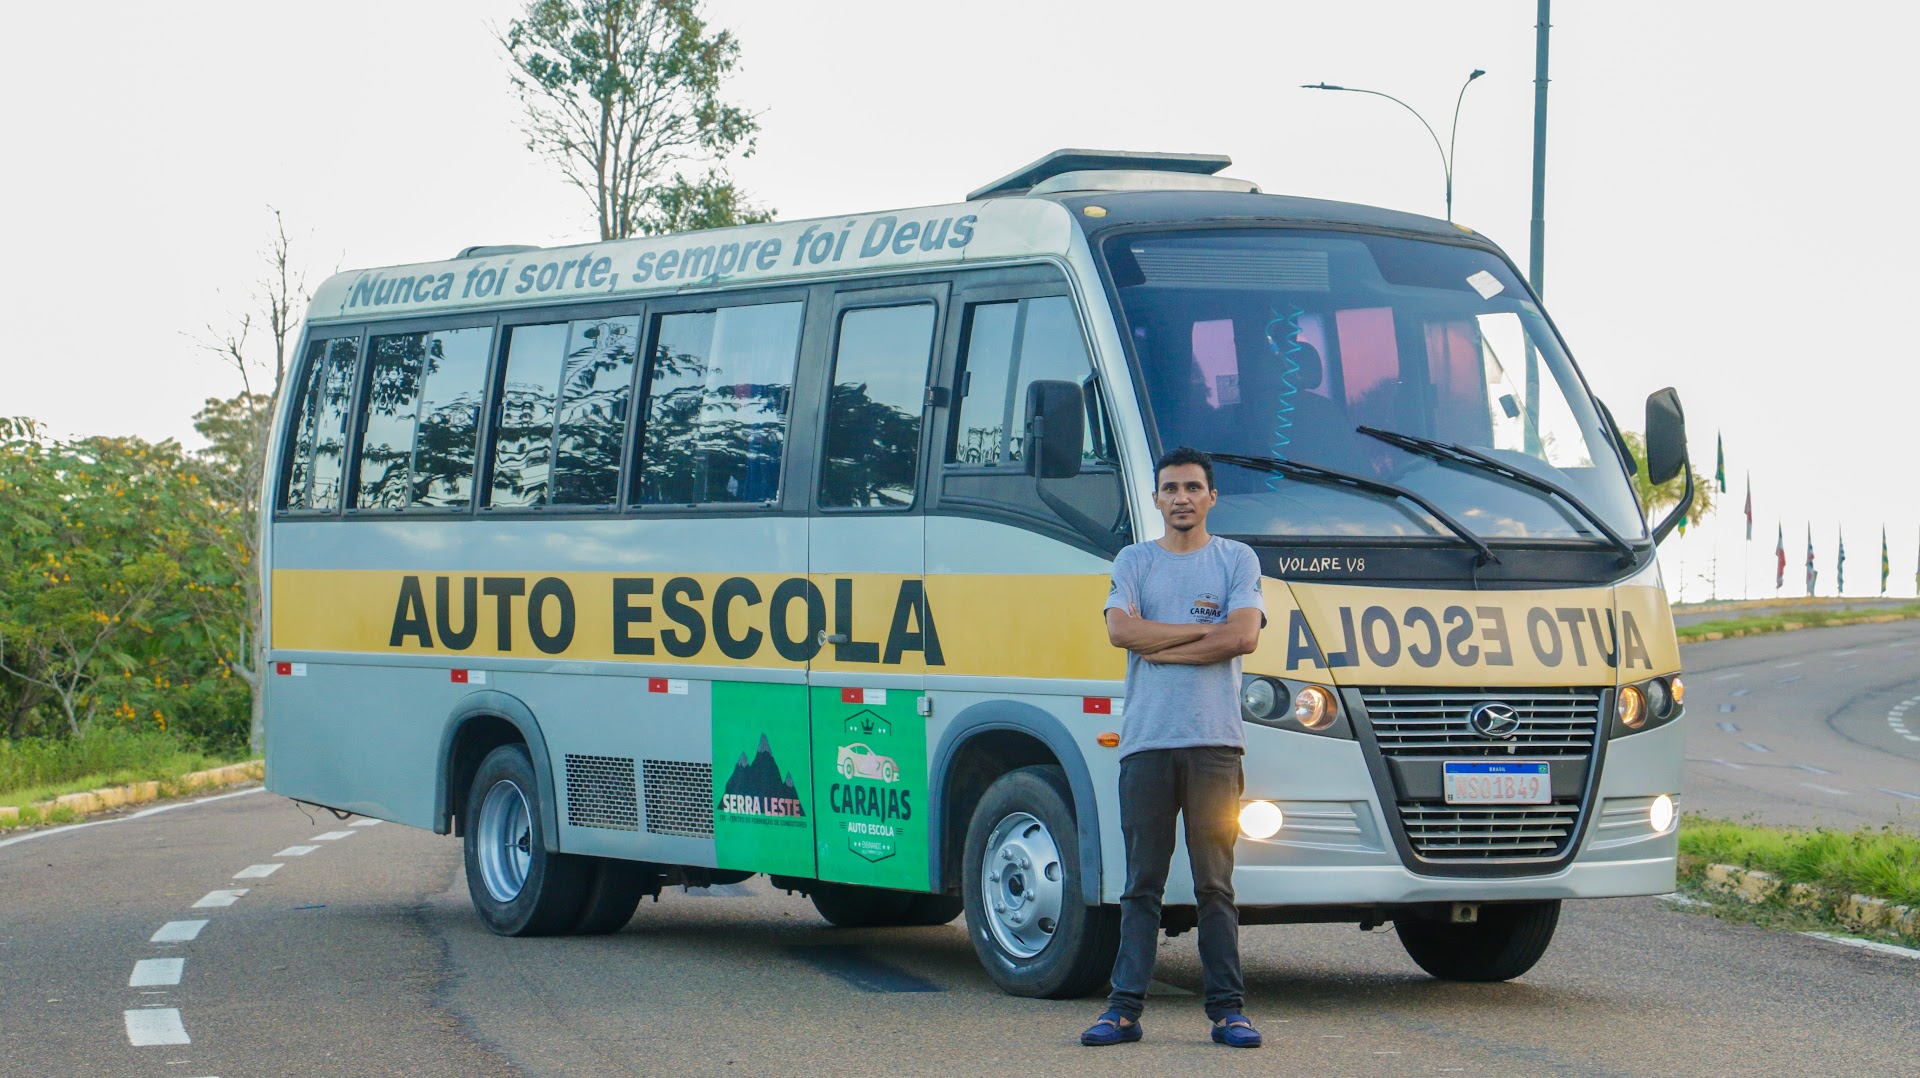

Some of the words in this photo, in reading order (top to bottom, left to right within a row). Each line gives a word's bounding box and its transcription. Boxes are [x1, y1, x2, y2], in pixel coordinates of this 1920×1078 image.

[349, 271, 455, 307] Nunca
[462, 258, 515, 298] foi
[515, 250, 619, 293] sorte,
[632, 237, 782, 285] sempre
[793, 219, 857, 266] foi
[859, 214, 979, 259] Deus
[1279, 557, 1342, 573] VOLARE
[1346, 557, 1365, 573] V8
[388, 575, 576, 654] AUTO
[612, 576, 946, 667] ESCOLA
[1190, 607, 1221, 617] CARAJAS
[722, 793, 761, 815] SERRA
[763, 797, 801, 818] LESTE
[830, 783, 912, 823] CARAJAS
[780, 820, 807, 829] CONDUTORES
[848, 822, 867, 834] AUTO
[868, 824, 895, 837] ESCOLA
